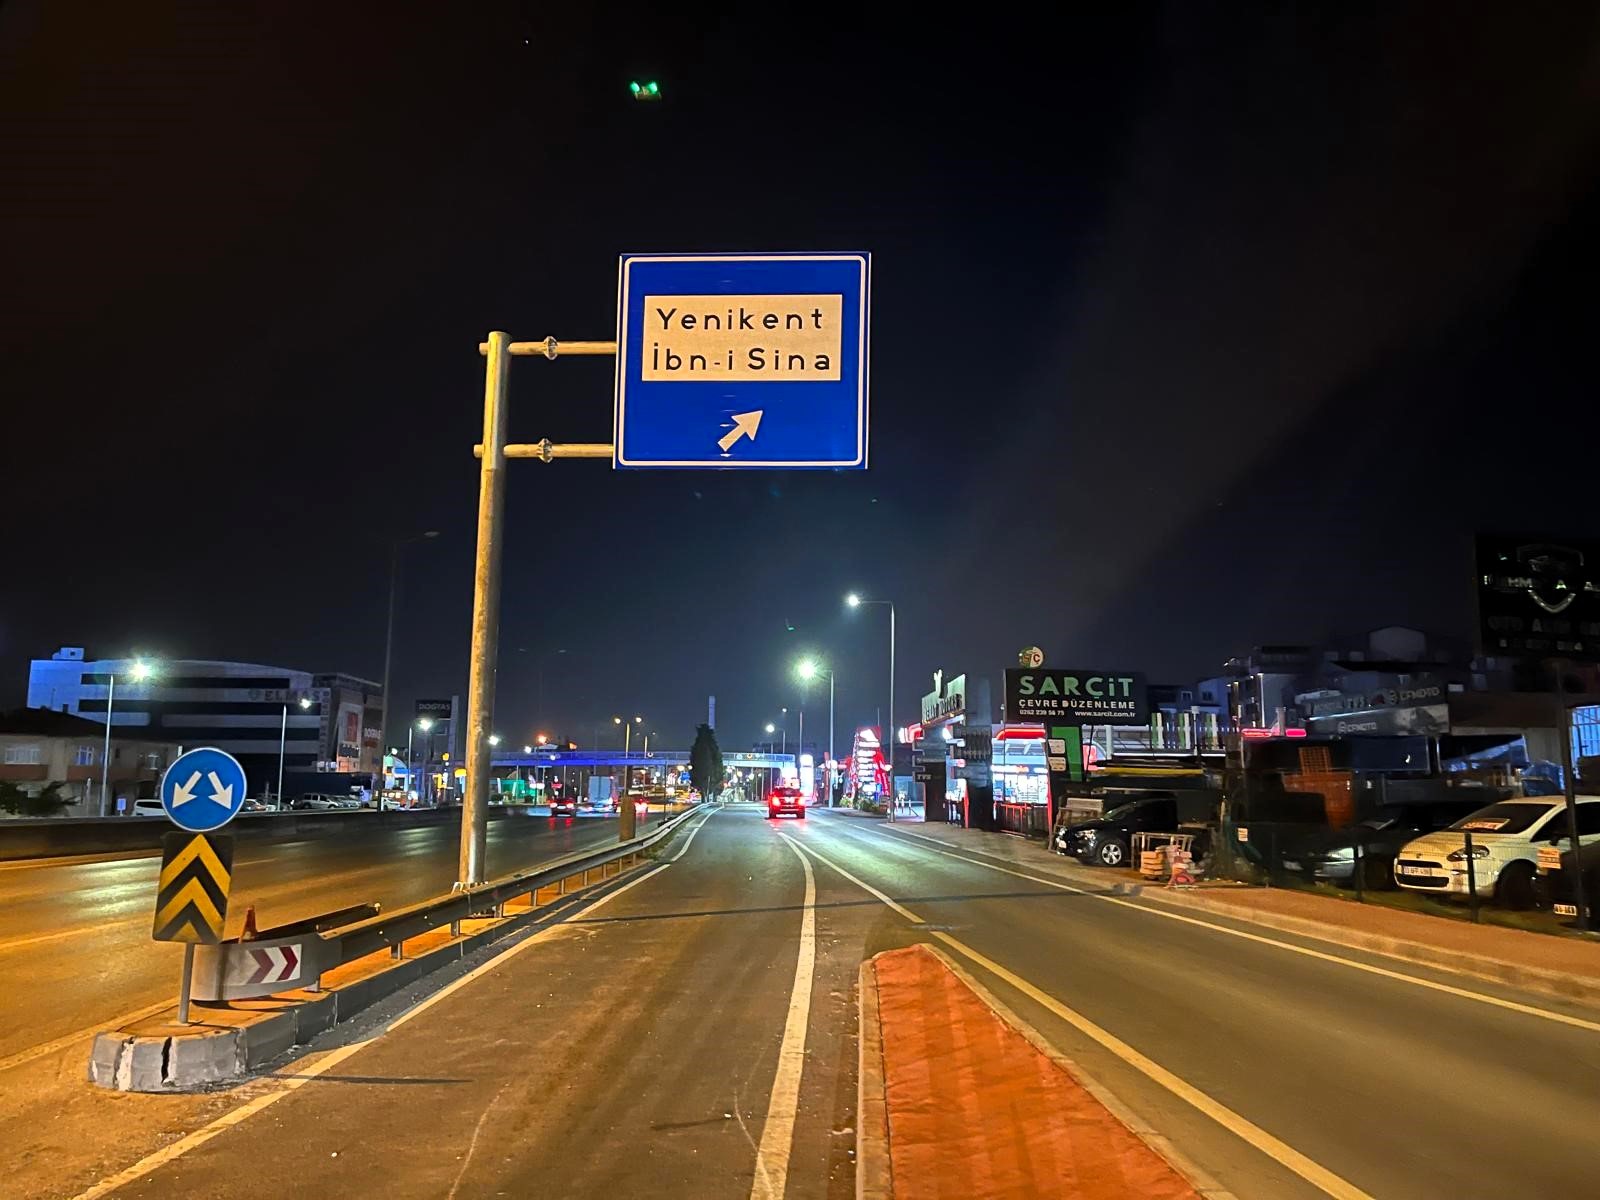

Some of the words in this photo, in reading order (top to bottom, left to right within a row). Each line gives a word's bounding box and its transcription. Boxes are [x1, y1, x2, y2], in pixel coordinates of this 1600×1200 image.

[656, 307, 823, 331] Yenikent
[652, 342, 734, 371] İbn-i
[747, 347, 831, 371] Sina
[1018, 699, 1058, 709] ÇEVRE
[1061, 698, 1136, 709] DÜZENLEME
